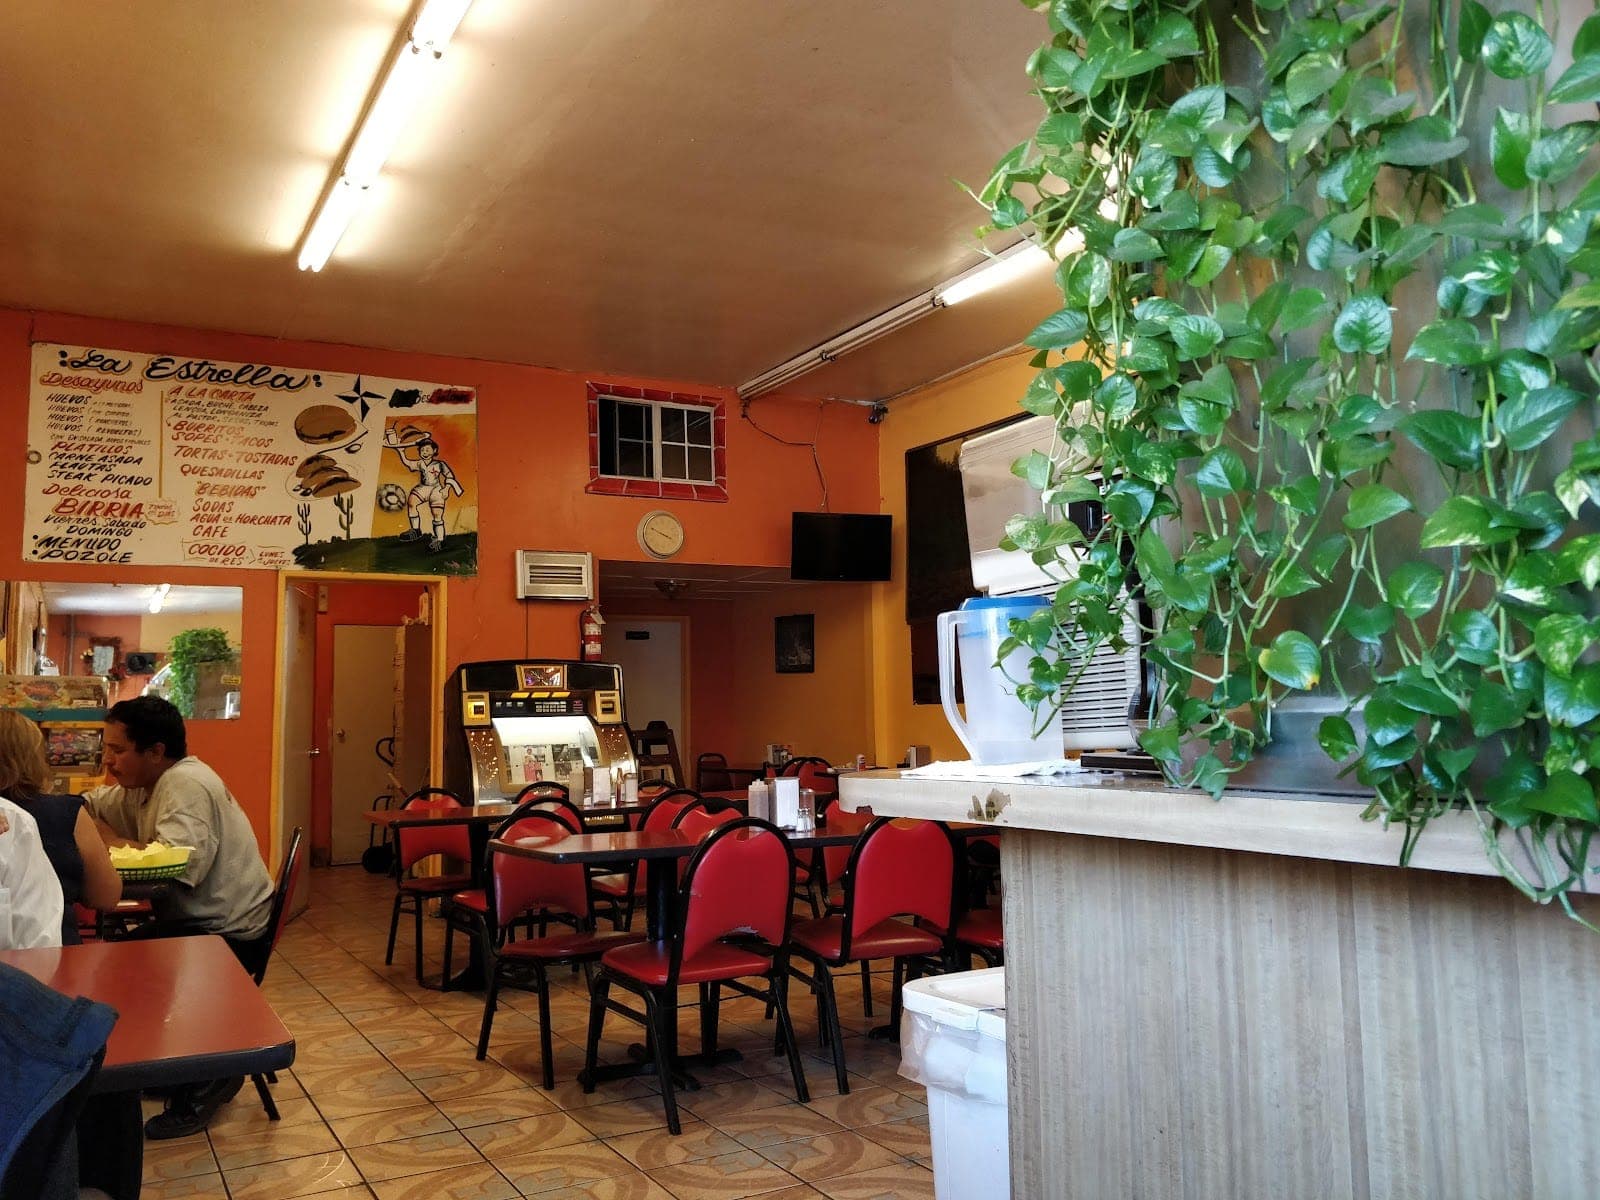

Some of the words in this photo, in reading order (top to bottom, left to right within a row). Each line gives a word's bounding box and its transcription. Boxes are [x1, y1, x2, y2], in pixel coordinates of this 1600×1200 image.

[70, 350, 131, 373] La
[146, 357, 310, 390] Estrella
[41, 371, 144, 394] Desayunos
[47, 393, 92, 405] HUEVOS
[169, 385, 184, 396] A
[187, 387, 208, 399] LA
[212, 388, 256, 402] CARTA
[48, 405, 84, 414] HUEVOS
[48, 413, 83, 422] HUEVOS
[47, 422, 82, 432] HUEVOS
[173, 420, 245, 435] BURRITOS
[172, 431, 222, 443] SOPES
[233, 435, 273, 448] TACOS
[50, 441, 132, 455] PLATILLOS
[49, 452, 95, 462] CARNE
[98, 455, 143, 465] ASADA
[174, 445, 226, 460] TORTAS
[236, 451, 298, 466] TOSTADAS
[49, 462, 116, 472] FLAUTAS
[181, 464, 264, 480] QUESADILLAS
[48, 470, 97, 481] STEAK
[101, 474, 153, 486] PICADO
[42, 483, 132, 499] Deliciosa
[54, 498, 144, 519] BIRRIA
[190, 513, 219, 524] AGUA
[235, 513, 292, 526] HORCHATA
[66, 526, 133, 537] DOMINGO
[192, 525, 229, 538] CAFE
[38, 537, 121, 551] MENUDO
[188, 543, 247, 557] COCIDO
[40, 550, 133, 563] POZOLE
[221, 556, 243, 566] RES
